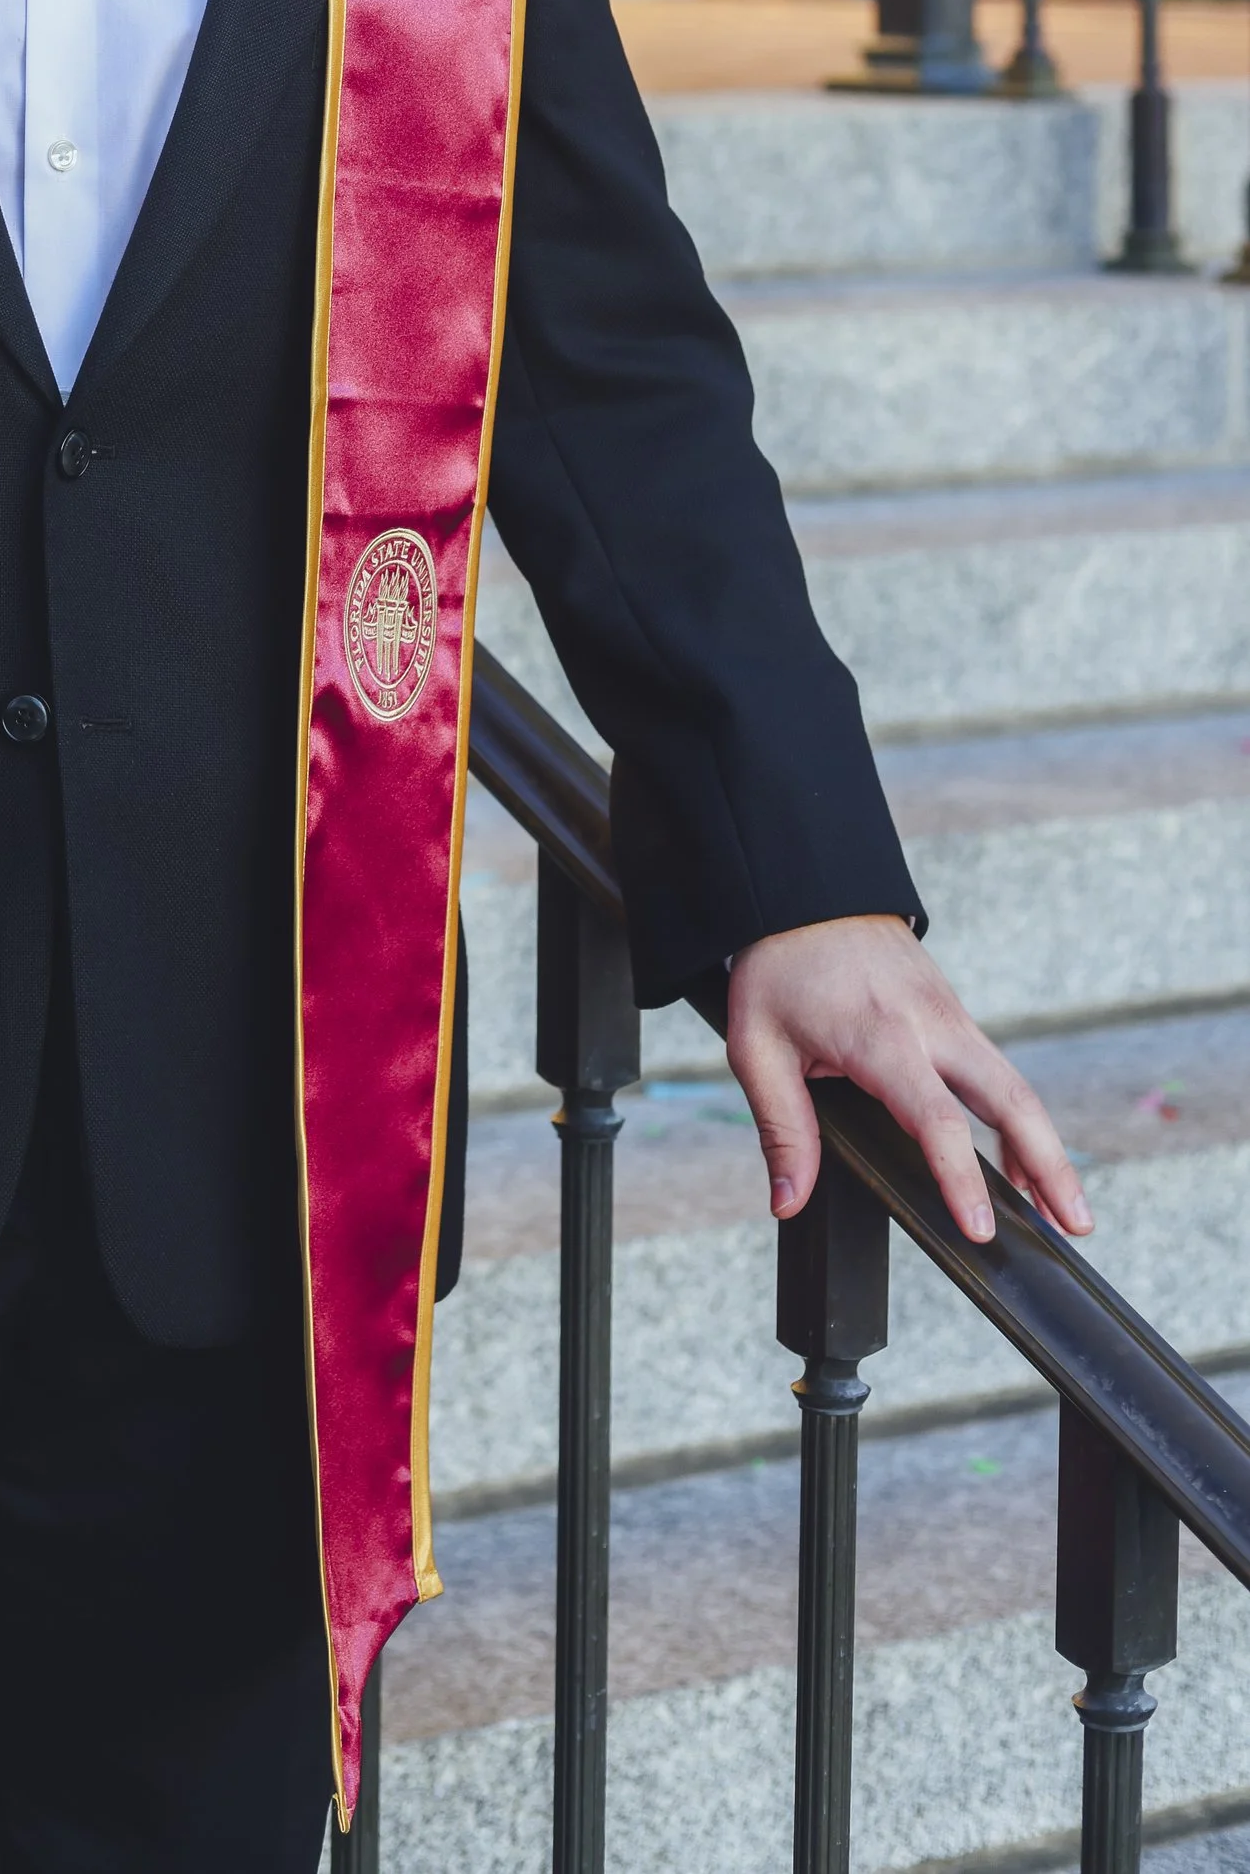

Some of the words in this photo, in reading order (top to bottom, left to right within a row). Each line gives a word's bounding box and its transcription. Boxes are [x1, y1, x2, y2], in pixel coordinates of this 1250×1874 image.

[349, 569, 371, 672] FLORIDA
[371, 540, 411, 567] STATE
[411, 548, 433, 676] UNIVERSITY
